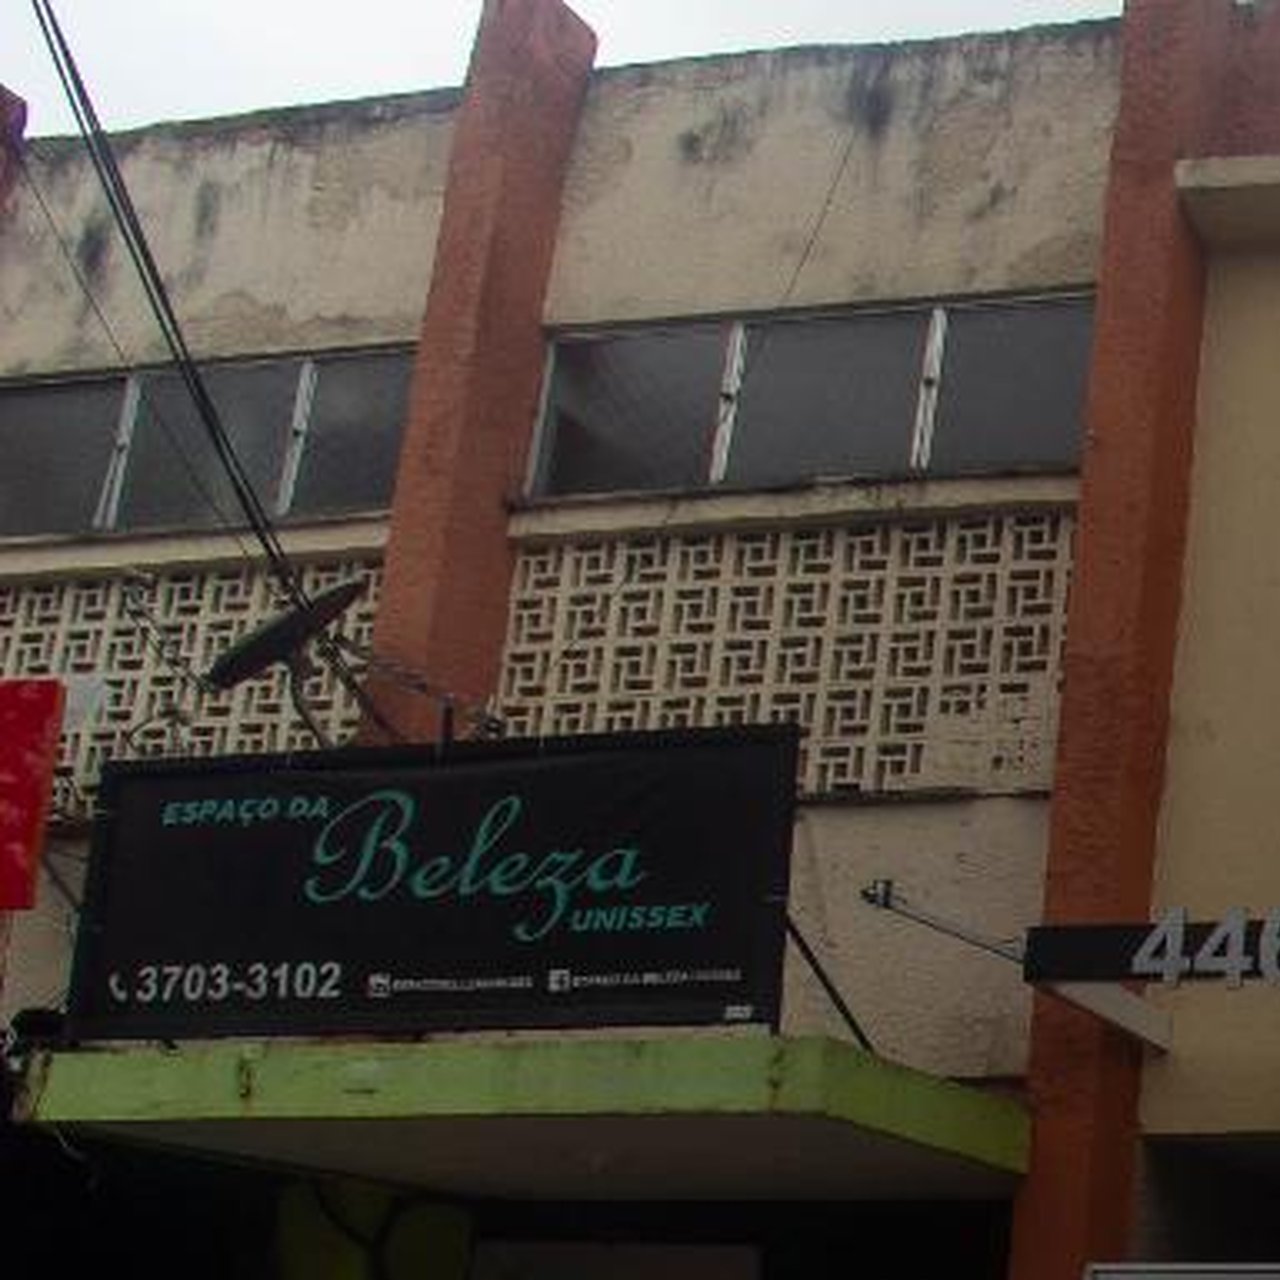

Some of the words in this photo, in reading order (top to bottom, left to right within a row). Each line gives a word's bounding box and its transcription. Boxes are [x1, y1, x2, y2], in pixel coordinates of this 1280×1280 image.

[163, 797, 277, 827] ESPAÇO
[286, 797, 330, 818] DA
[303, 789, 647, 942] Beleza
[571, 903, 712, 932] UNISSEX
[136, 961, 343, 1003] 3703-3102
